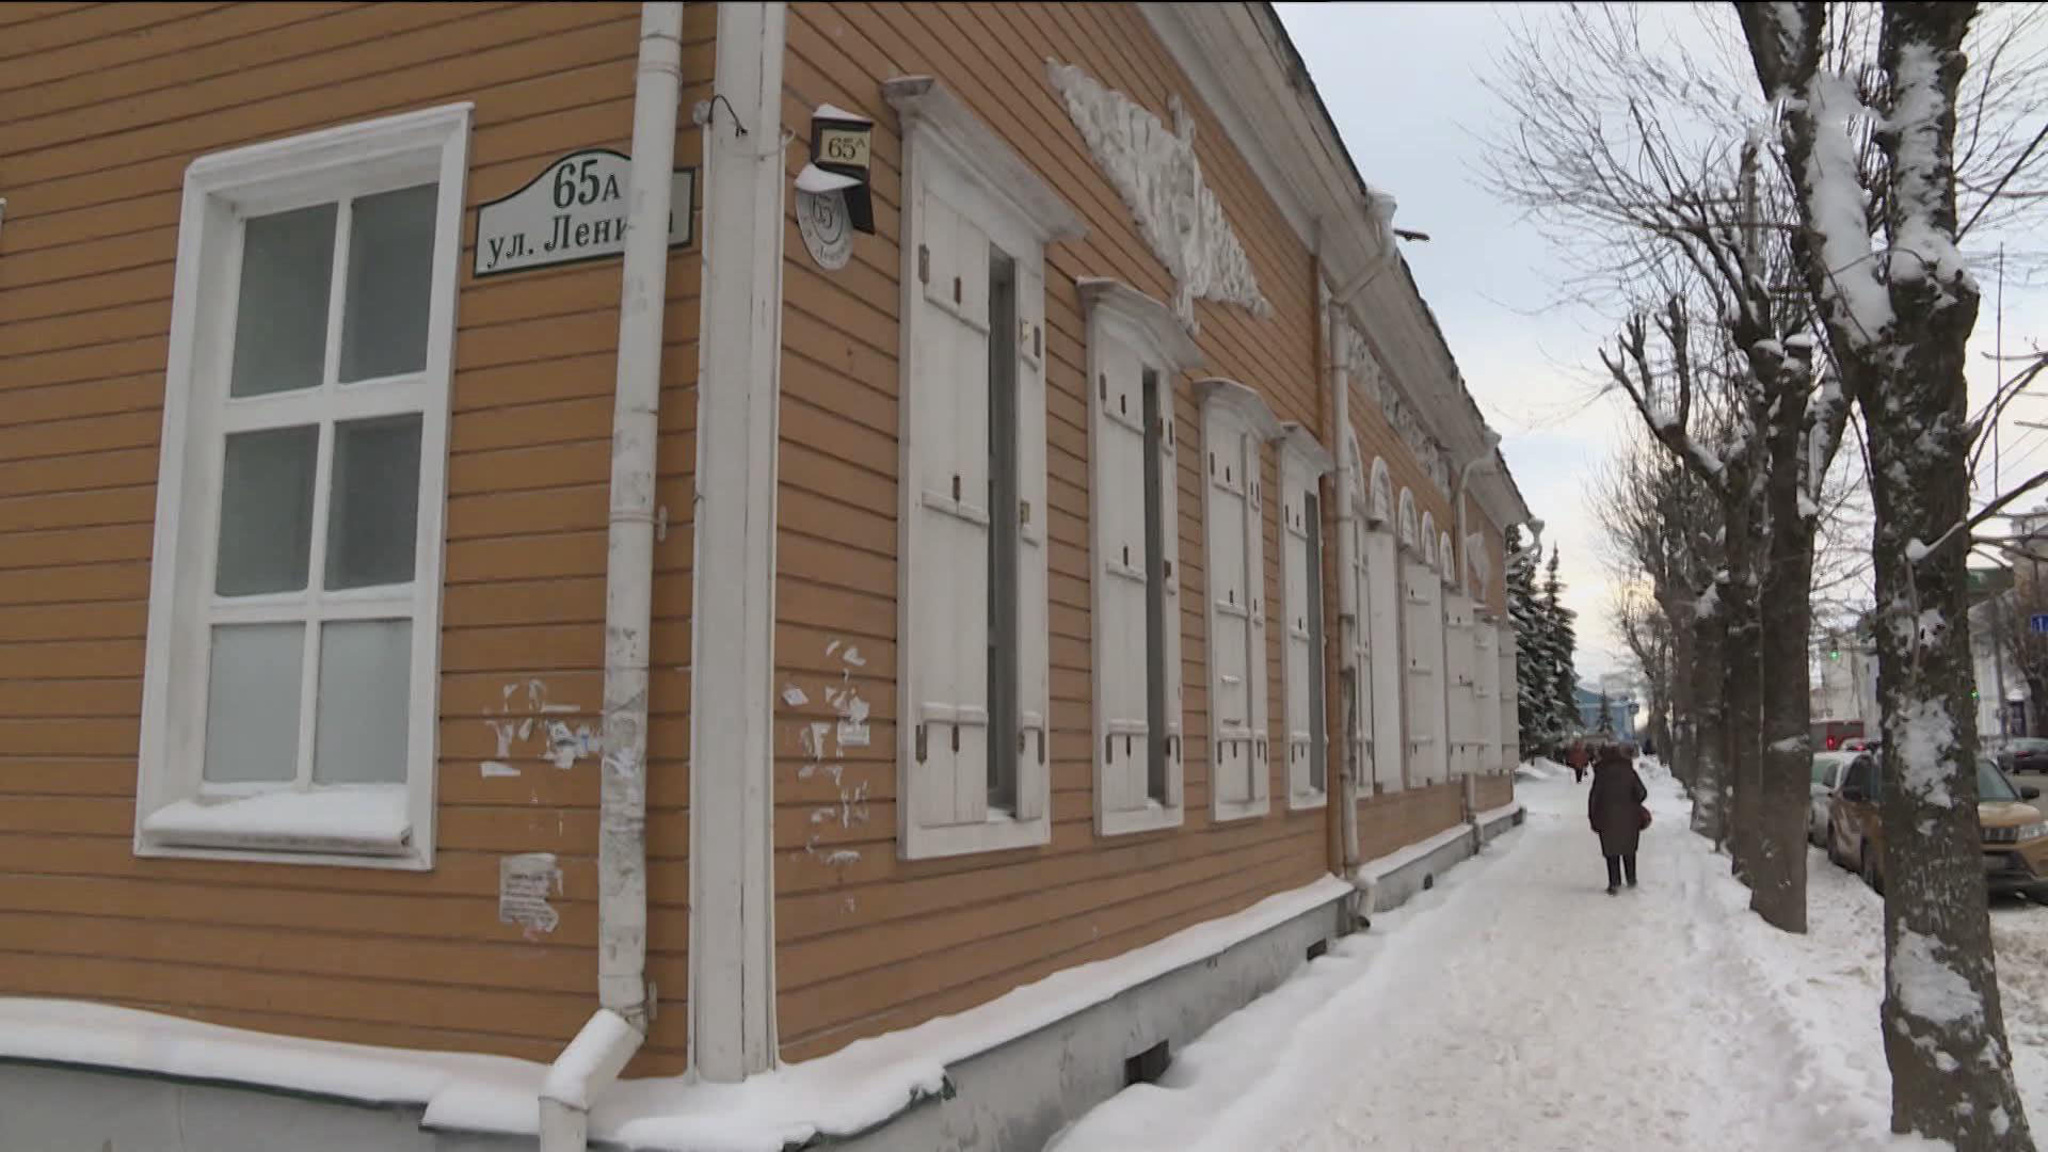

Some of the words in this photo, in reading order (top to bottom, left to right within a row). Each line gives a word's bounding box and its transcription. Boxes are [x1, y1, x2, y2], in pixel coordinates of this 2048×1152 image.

[553, 158, 620, 209] 65А
[486, 233, 534, 269] ул.
[543, 211, 673, 252] Лени
